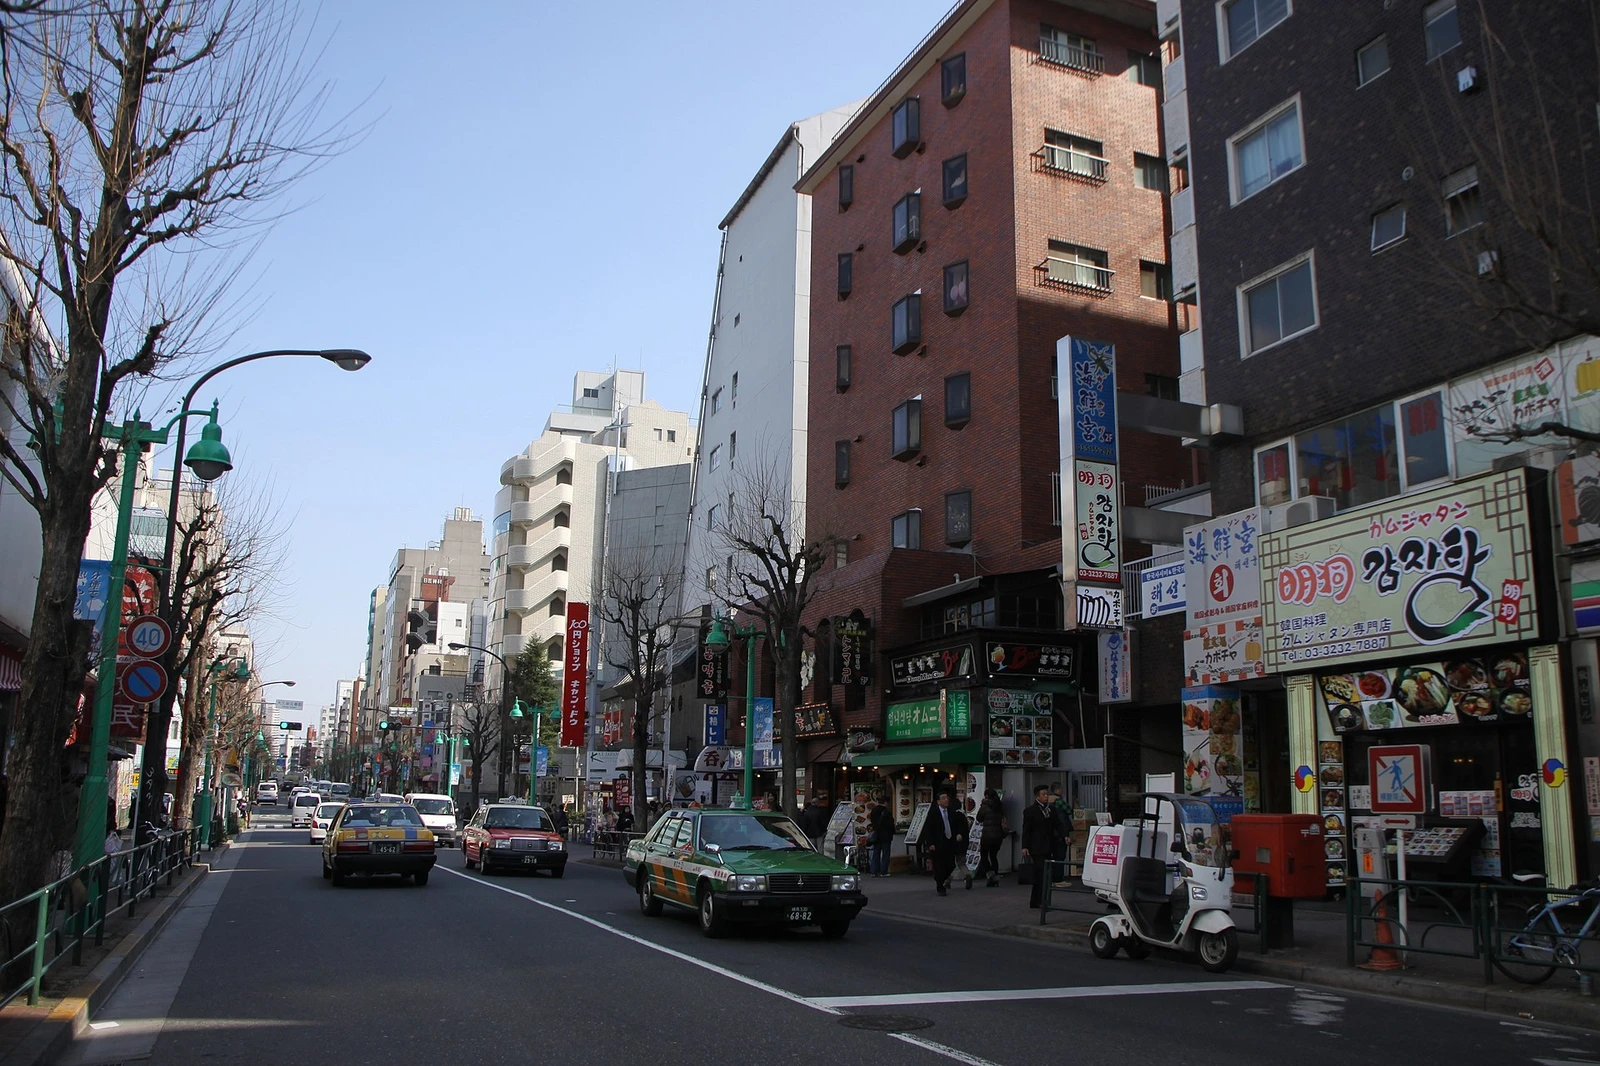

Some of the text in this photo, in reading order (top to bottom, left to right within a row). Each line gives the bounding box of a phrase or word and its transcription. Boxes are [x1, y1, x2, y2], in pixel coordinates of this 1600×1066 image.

[1079, 470, 1114, 490] 明洞
[1369, 501, 1469, 538] カムジャタン
[1188, 520, 1256, 565] 海鮮宮
[1279, 556, 1354, 604] 明洞
[1279, 613, 1328, 632] 韓国料理
[1281, 618, 1392, 647] カムジャタン専門店
[135, 628, 161, 646] 40
[1304, 637, 1387, 659] 03-3232-7887
[913, 706, 941, 725] オムニ
